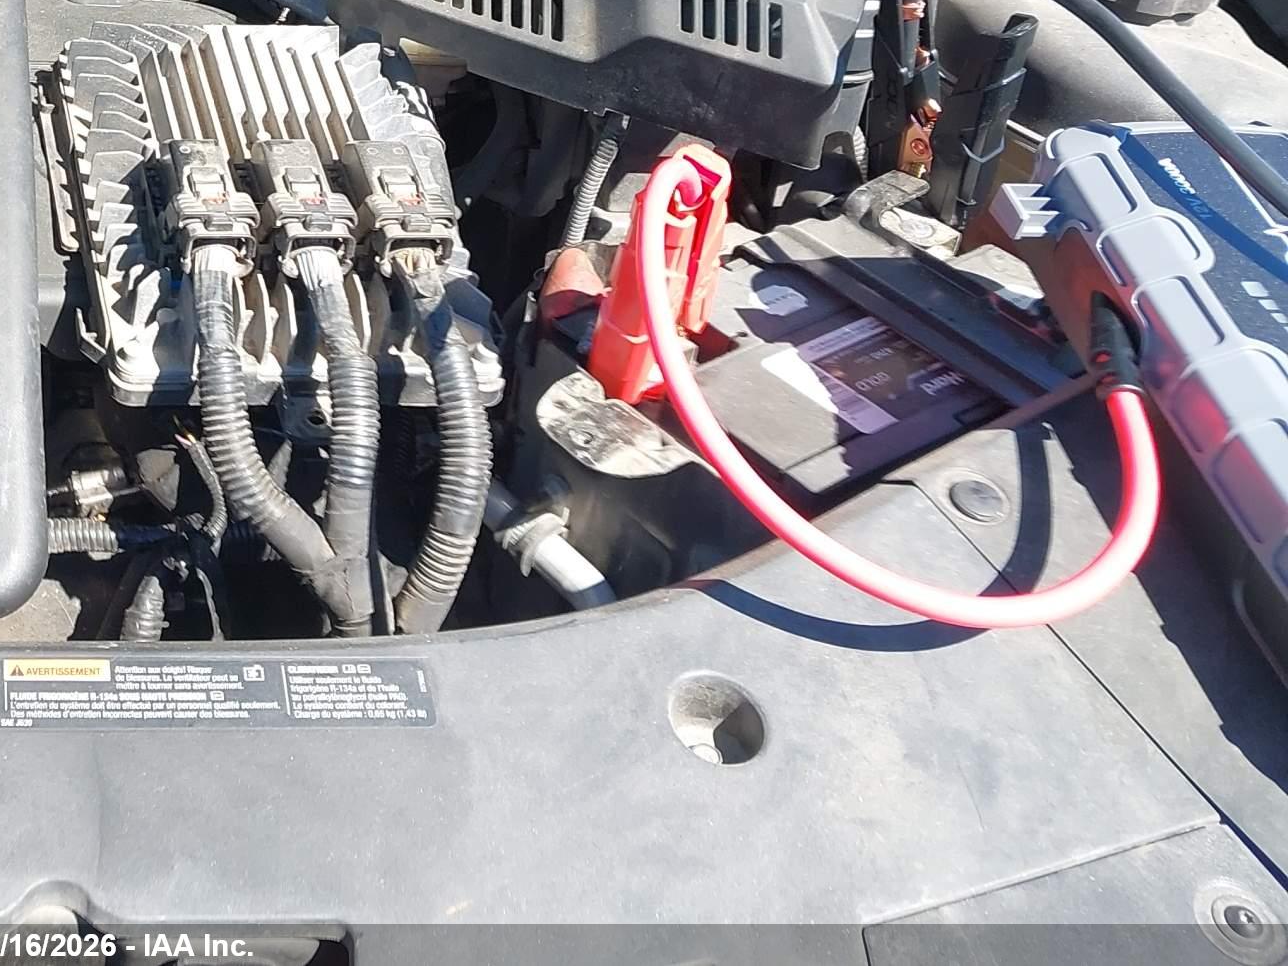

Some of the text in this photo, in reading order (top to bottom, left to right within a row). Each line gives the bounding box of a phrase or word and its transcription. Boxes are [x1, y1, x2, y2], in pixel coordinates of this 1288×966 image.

[855, 371, 890, 392] GOLD
[26, 667, 101, 675] AVERTISSEMENT
[115, 666, 146, 674] Attention
[147, 666, 161, 674] aux
[116, 674, 124, 682] de
[163, 674, 172, 682] Le
[173, 674, 210, 682] ventilateur
[212, 674, 228, 682] peut
[229, 674, 238, 682] se
[315, 676, 353, 684] seulement
[354, 676, 360, 684] le
[361, 676, 382, 684] fluide
[330, 685, 357, 693] R-134a
[358, 685, 365, 693] et
[367, 685, 377, 693] de
[11, 702, 280, 710] L'entretien du système doit être effectué par un personnel qualifié seulement.
[293, 702, 303, 710] Le
[304, 702, 334, 710] système
[335, 702, 364, 710] contient
[365, 702, 375, 710] du
[11, 710, 24, 718] Des
[26, 710, 61, 718] méthodes
[63, 710, 101, 718] d'entretien
[103, 710, 142, 718] incorrectes
[144, 710, 172, 718] peuvent
[173, 710, 198, 718] causer
[199, 710, 212, 718] des
[295, 711, 320, 719] Charge
[321, 711, 330, 719] du
[332, 711, 363, 719] système
[386, 711, 396, 719] kg
